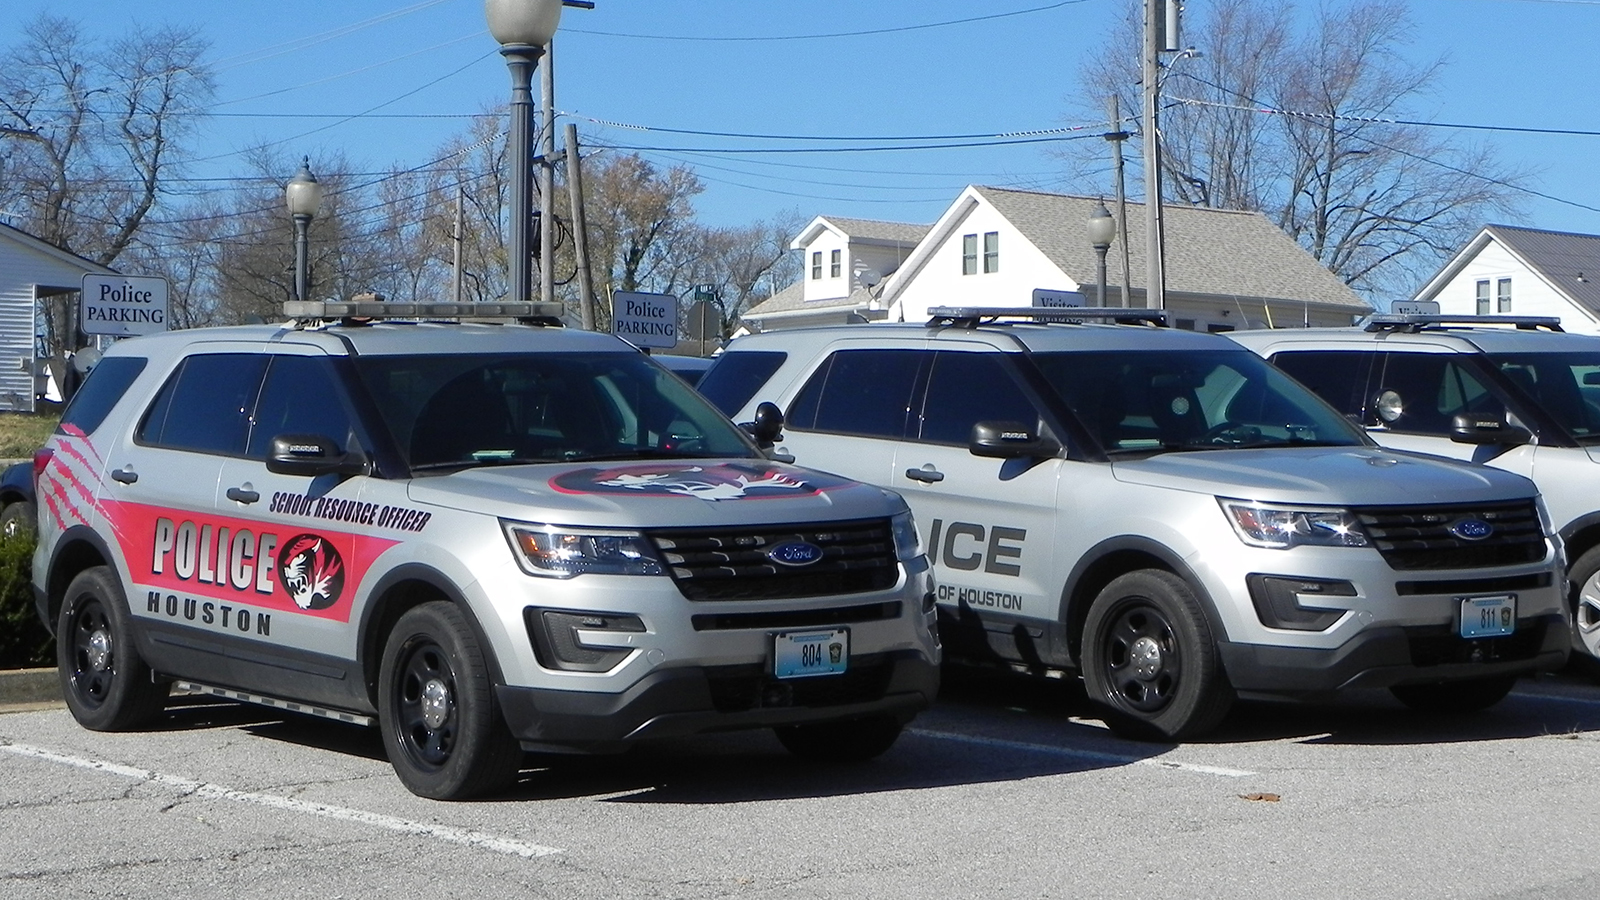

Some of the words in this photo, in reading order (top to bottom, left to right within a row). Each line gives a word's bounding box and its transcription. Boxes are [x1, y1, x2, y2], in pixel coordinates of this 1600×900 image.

[99, 284, 152, 303] Police
[87, 306, 164, 324] PARKING
[626, 300, 665, 318] Police
[616, 320, 674, 337] PARKING
[269, 491, 314, 516] SCHOOL
[313, 496, 380, 526] RESOURCE
[377, 505, 432, 533] OFFICER
[152, 517, 278, 595] POLICE
[784, 545, 813, 560] Ford
[938, 584, 955, 600] OF
[958, 587, 1022, 611] HOUSTON
[147, 591, 271, 637] HOUSTON
[1480, 608, 1496, 629] 811
[802, 643, 822, 667] 804
